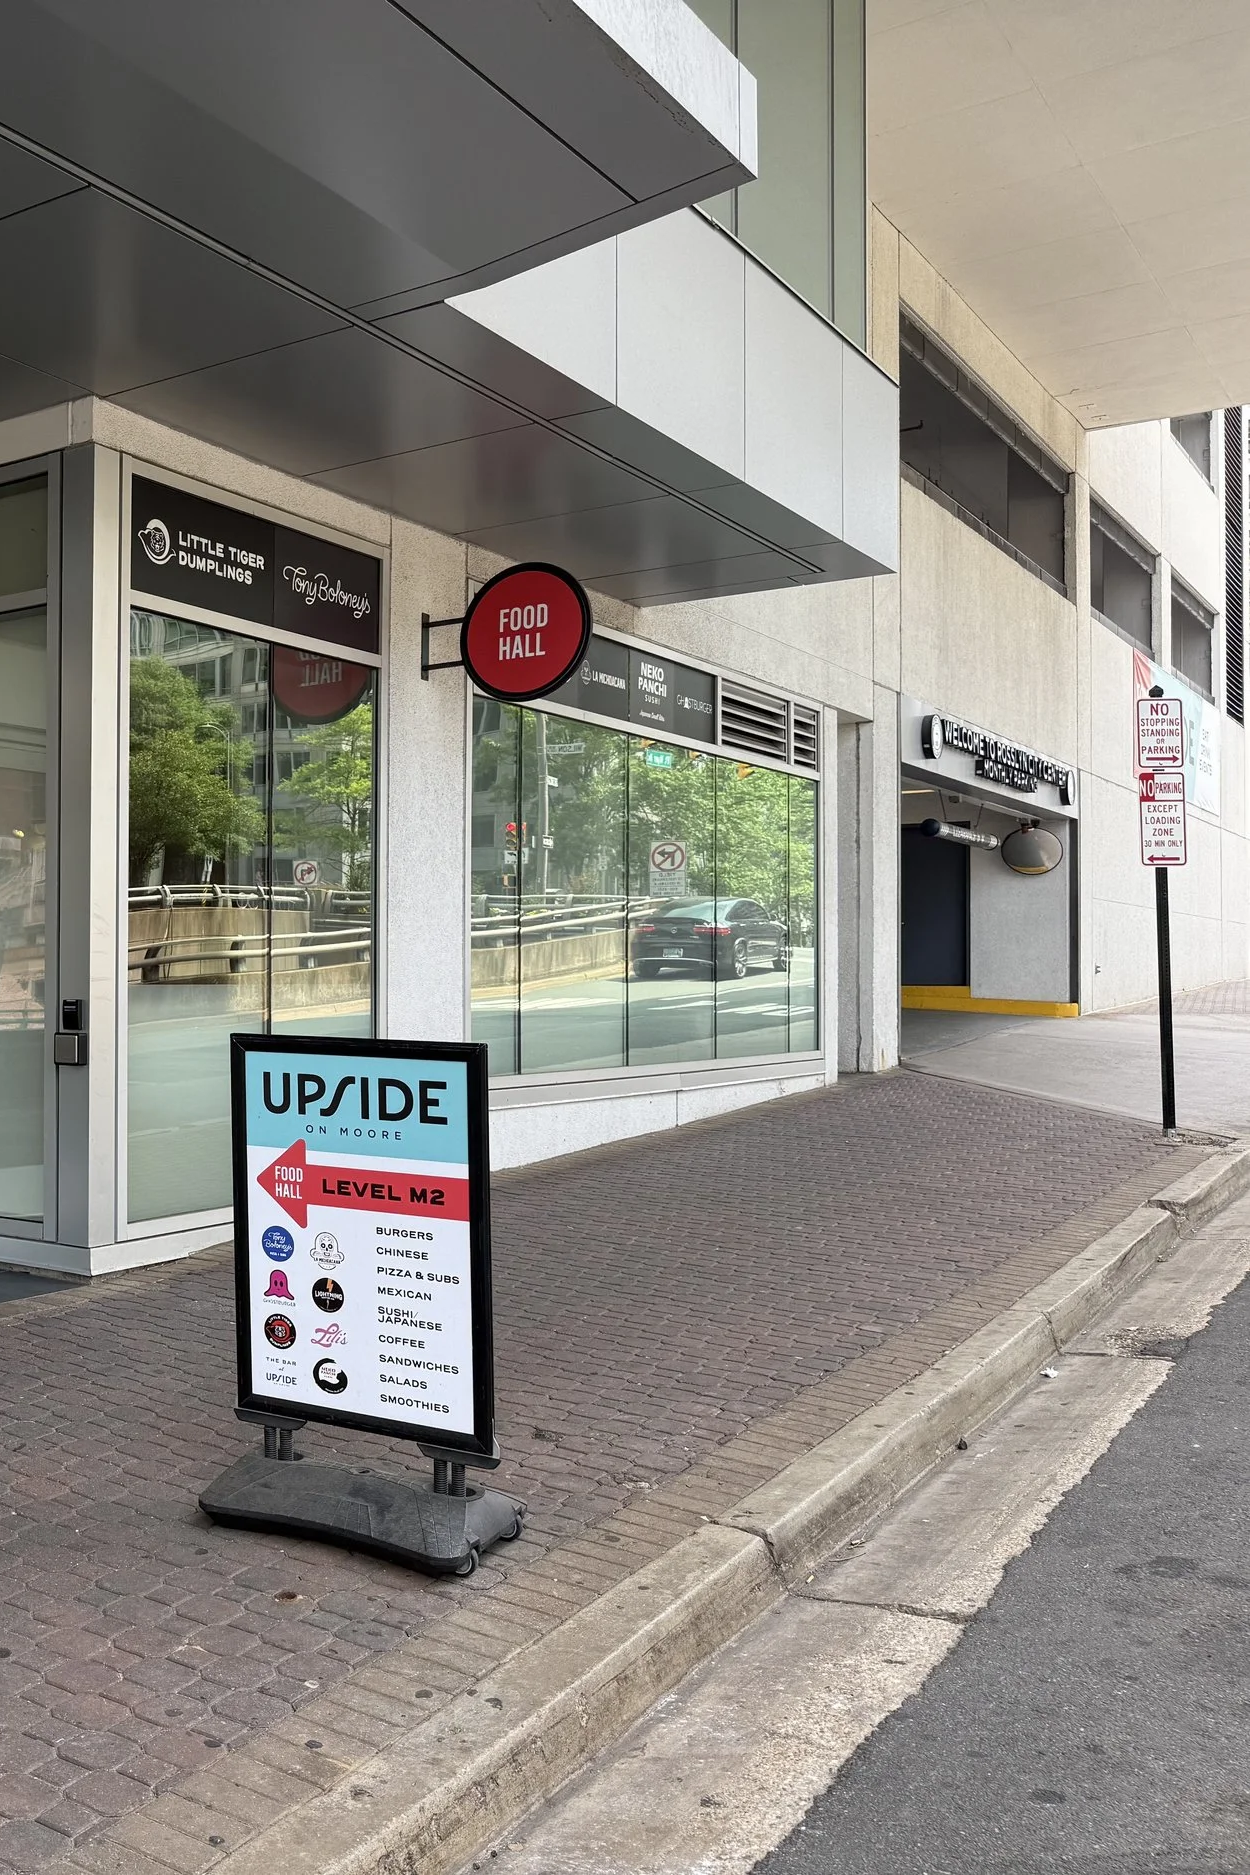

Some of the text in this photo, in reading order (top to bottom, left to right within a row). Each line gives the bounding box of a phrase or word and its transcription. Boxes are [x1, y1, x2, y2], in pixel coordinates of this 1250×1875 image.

[178, 530, 265, 570] LITTLE TIGER
[178, 551, 253, 585] DUMPLINGS
[283, 565, 318, 605] Tony
[499, 603, 548, 633] FOOD
[498, 632, 546, 661] HALL
[592, 670, 598, 682] LA
[640, 662, 664, 682] NEKO
[638, 677, 667, 697] PANCHI
[1150, 703, 1169, 716] NO
[1140, 718, 1180, 727] STOPPING
[944, 719, 985, 757] WELCOME
[985, 736, 996, 760] TO
[1141, 728, 1180, 737] STANDING
[1141, 746, 1181, 755] PARKING
[1140, 779, 1183, 798] NO PARKING
[1147, 805, 1178, 813] EXCEPT
[1145, 816, 1181, 825] LOADING
[1152, 828, 1175, 837] ZONE
[1144, 839, 1183, 848] 30 MIN ONLY
[263, 1071, 448, 1126] UPSIDE
[305, 1124, 402, 1141] ON MOORE
[275, 1166, 304, 1182] FOOD
[275, 1182, 302, 1200] HALL
[322, 1178, 445, 1206] LEVEL M2
[376, 1227, 434, 1241] BURGERS
[376, 1247, 429, 1261] CHINESE
[377, 1266, 460, 1285] PIZZA & SUBS
[377, 1286, 432, 1301] MEXICAN
[378, 1306, 419, 1319] SUSHI/
[377, 1316, 443, 1332] JAPANESE
[311, 1323, 349, 1348] Lili's
[378, 1334, 426, 1349] COFFEE
[265, 1356, 297, 1367] THE BAR
[379, 1354, 459, 1375] SANDWICHES
[265, 1372, 298, 1386] UPSIDE
[379, 1374, 428, 1390] SALADS
[380, 1394, 450, 1414] SMOOTHIES
